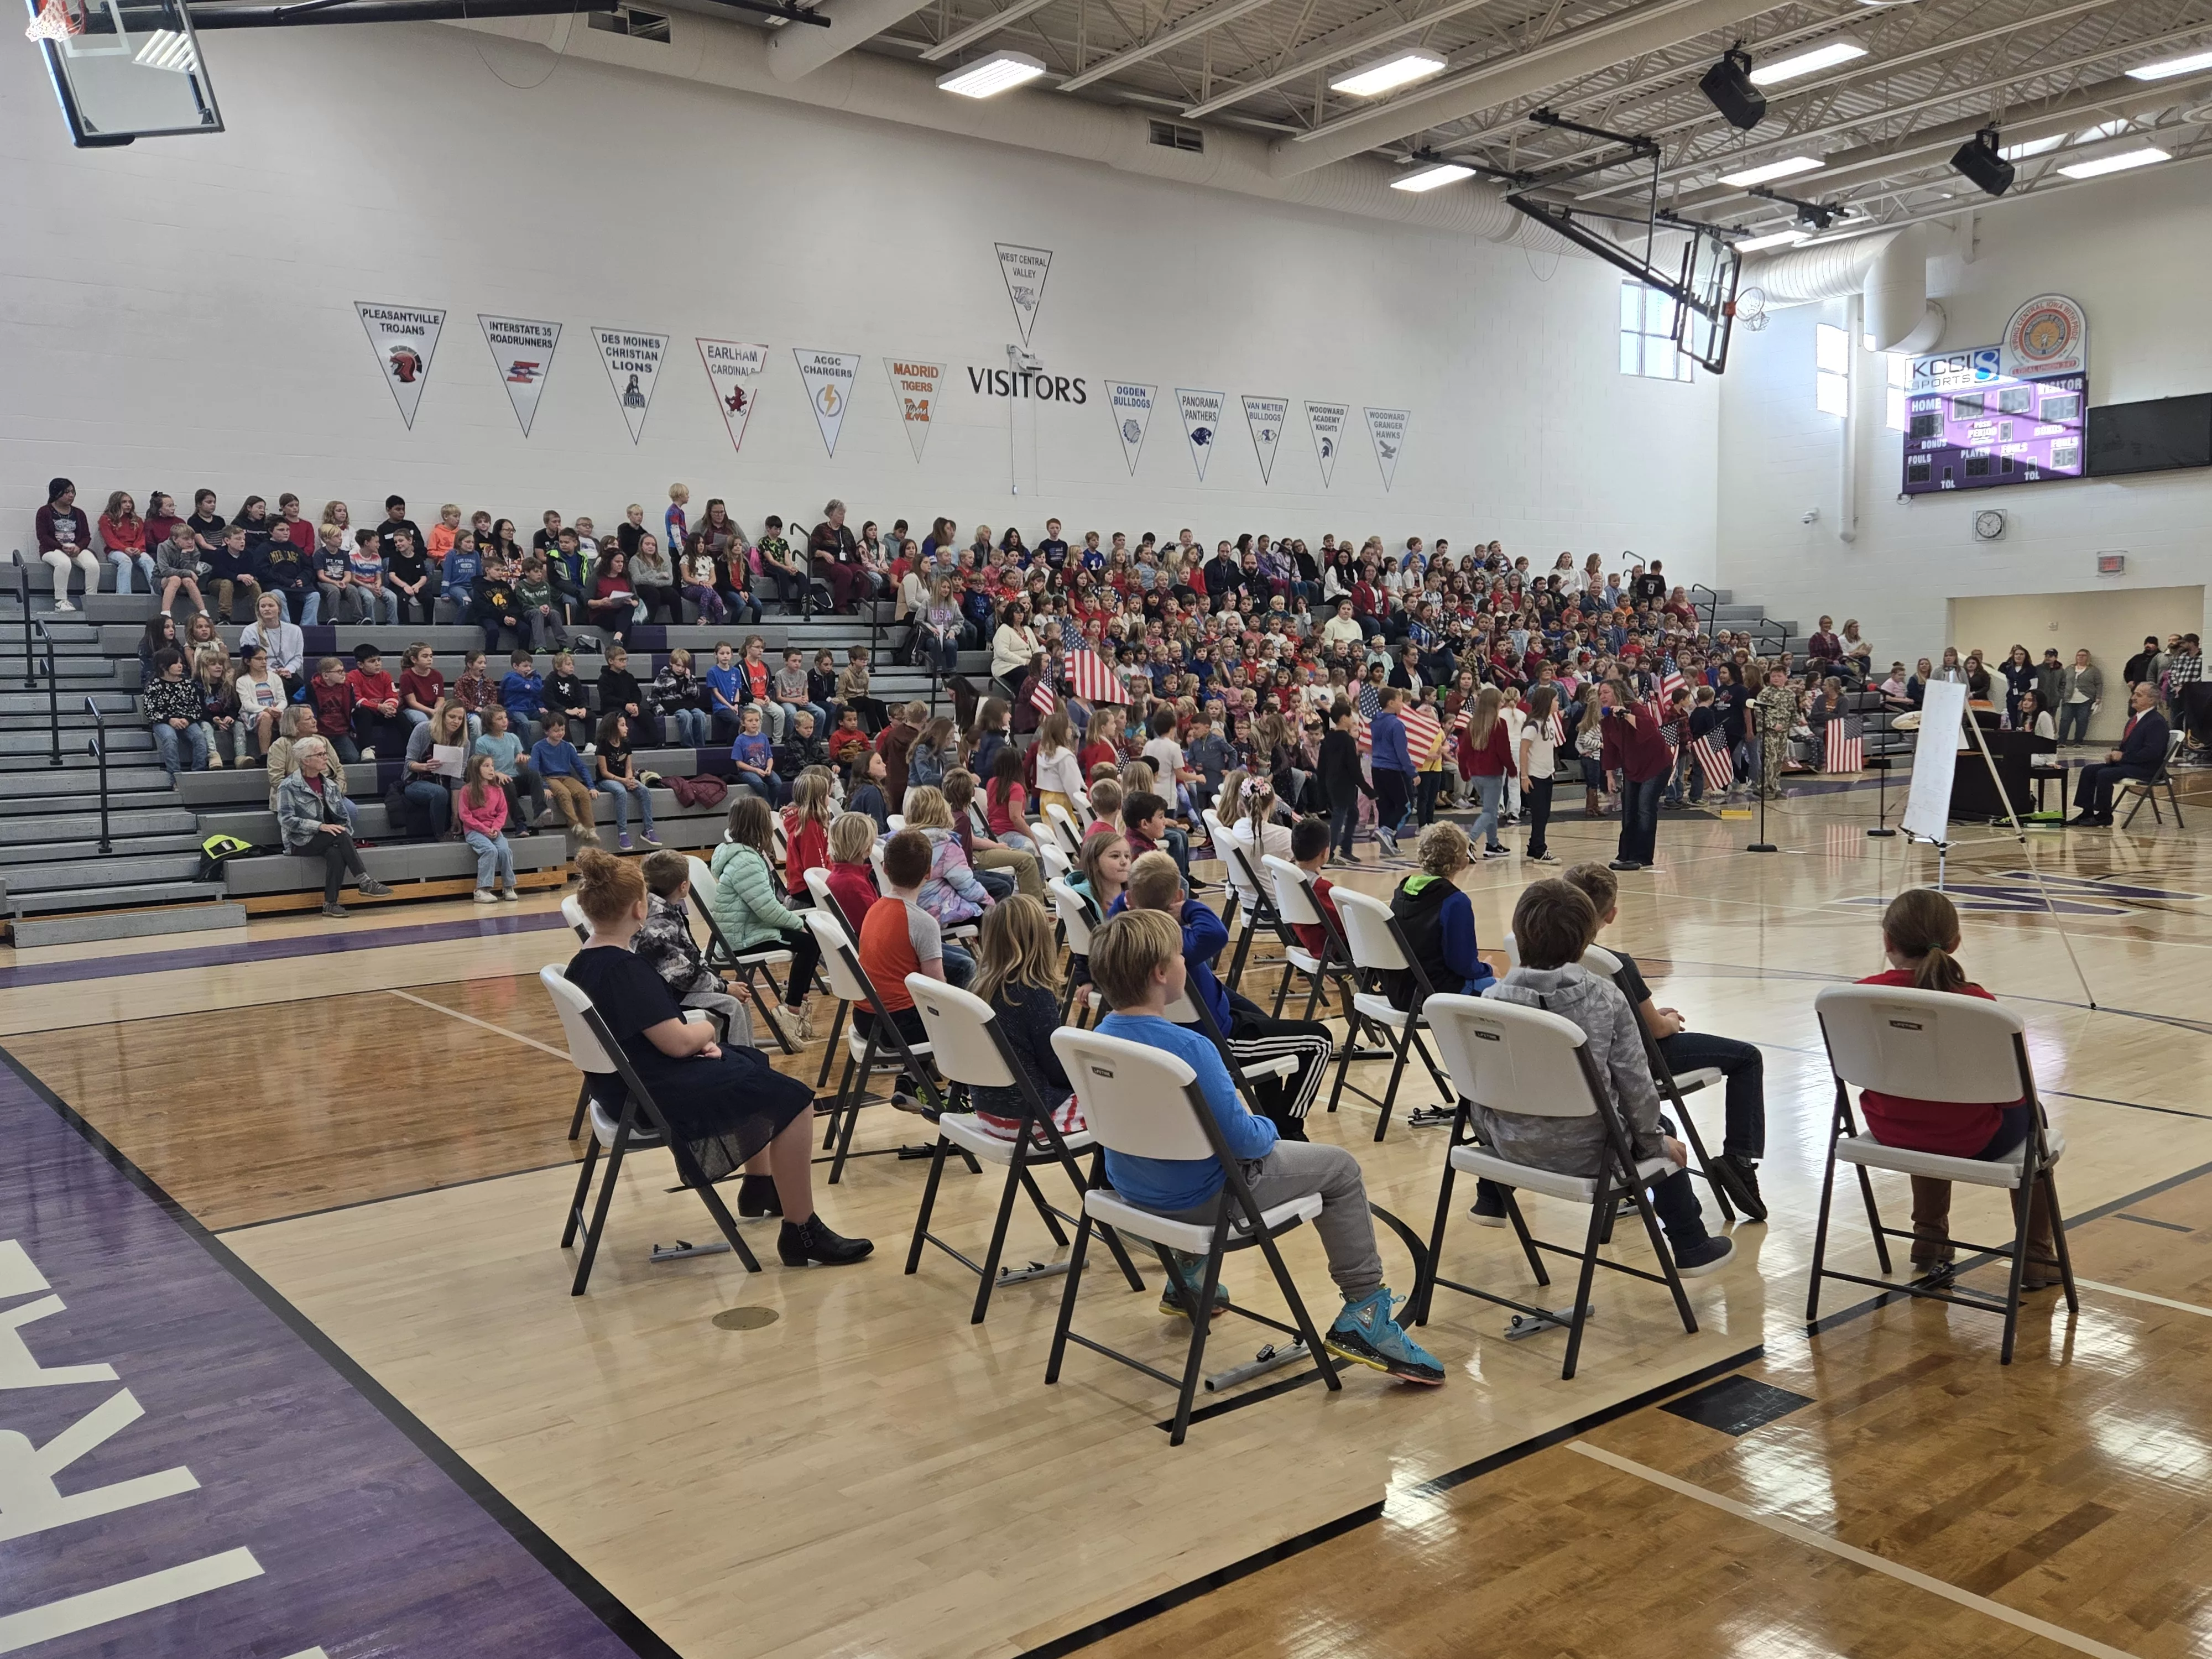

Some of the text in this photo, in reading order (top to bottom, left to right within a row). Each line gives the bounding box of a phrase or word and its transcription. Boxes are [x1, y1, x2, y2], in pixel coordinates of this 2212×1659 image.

[1000, 252, 1047, 267] WEST CENTRAL
[1013, 267, 1036, 279] VALLEY
[362, 308, 440, 324] PLEASANTVILLE
[379, 323, 425, 336] TROJANS
[489, 321, 552, 337] INTERSTATE 35
[2011, 326, 2021, 352] WIRING
[2018, 302, 2044, 326] CENTRAL
[2046, 301, 2063, 310] IOWA
[2063, 307, 2077, 322] WITH
[2070, 321, 2079, 341] PRIDE
[490, 333, 553, 348] ROADRUNNERS
[601, 333, 660, 349] DES MOINES
[606, 347, 658, 361] CHRISTIAN
[707, 345, 758, 362] EARLHAM
[612, 360, 653, 373] LIONS
[814, 355, 841, 366] ACGC
[1912, 354, 1971, 379] KCCI
[804, 366, 852, 378] CHARGERS
[894, 363, 938, 379] MADRID
[901, 380, 933, 393] TIGERS
[967, 366, 1087, 405] VISITORS
[1911, 374, 1971, 390] SPORTS
[2038, 378, 2083, 394] VISITOR
[1117, 386, 1146, 398] OGDEN
[1114, 396, 1151, 409] BULLDOGS
[1182, 396, 1219, 409] PANORAMA
[1246, 401, 1284, 412] VAN METER
[1912, 398, 1942, 412] HOME
[1185, 410, 1217, 422] PANTHERS
[1249, 411, 1281, 422] BULLDOGS
[1308, 405, 1344, 416] WOODWARD
[1369, 411, 1405, 421] WOODWARD
[1312, 415, 1340, 424] ACADEMY
[1374, 421, 1404, 430] GRANGER
[1316, 424, 1338, 432] KNIGHTS
[1967, 426, 1997, 439] PERIOD
[1376, 430, 1400, 440] HAWKS
[1921, 439, 1947, 450] BONUS
[1961, 447, 1990, 458] PLAYER
[1908, 454, 1932, 465] FOULS
[2024, 471, 2040, 481] TOL
[1940, 479, 1955, 489] TOL
[931, 609, 952, 621] USA
